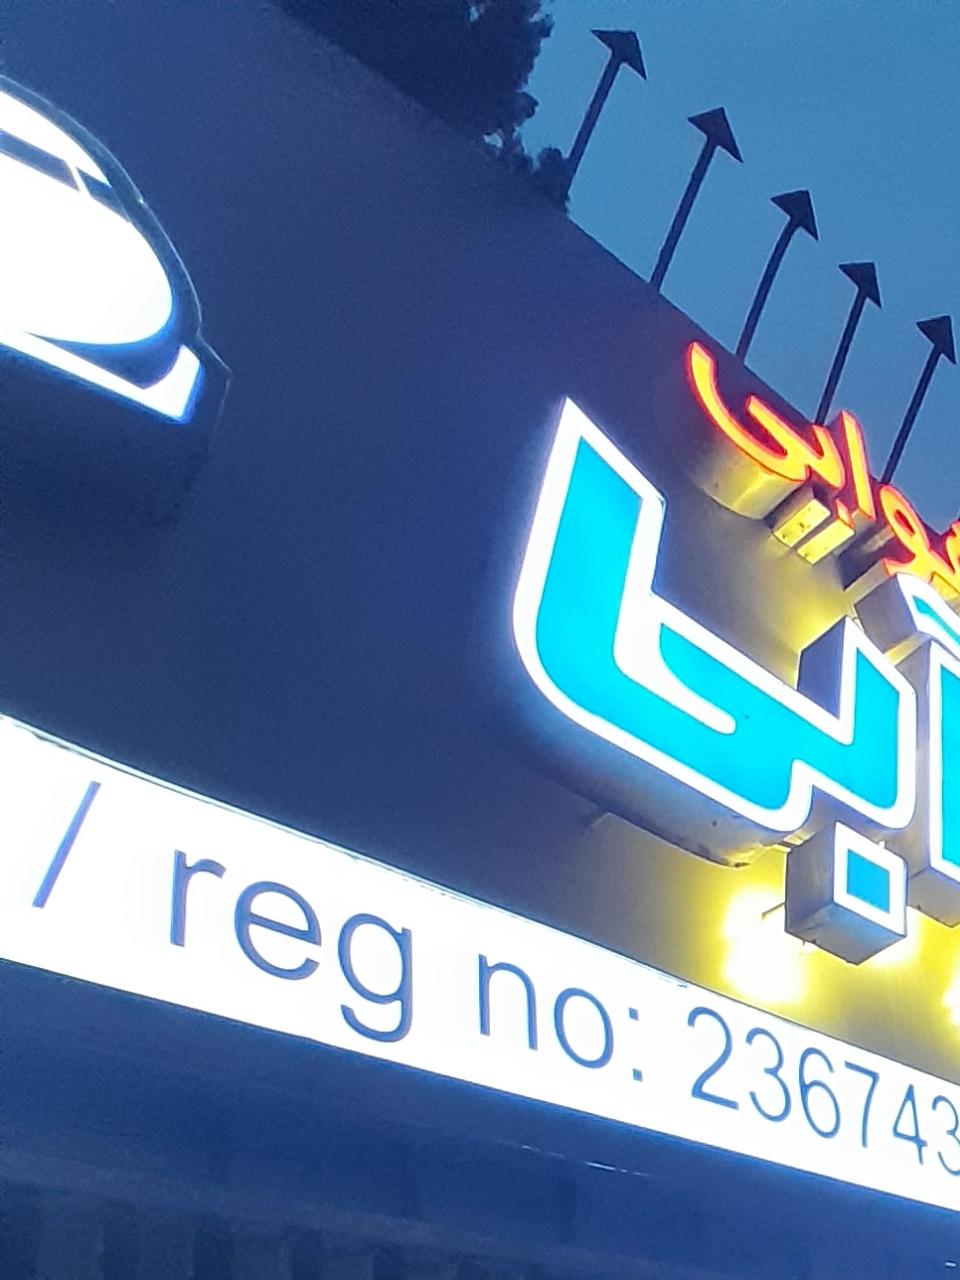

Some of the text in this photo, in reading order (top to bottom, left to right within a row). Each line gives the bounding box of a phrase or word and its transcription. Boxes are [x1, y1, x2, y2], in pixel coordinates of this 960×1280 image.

[32, 781, 101, 909] /
[169, 848, 413, 1043] reg
[478, 953, 643, 1081] no:
